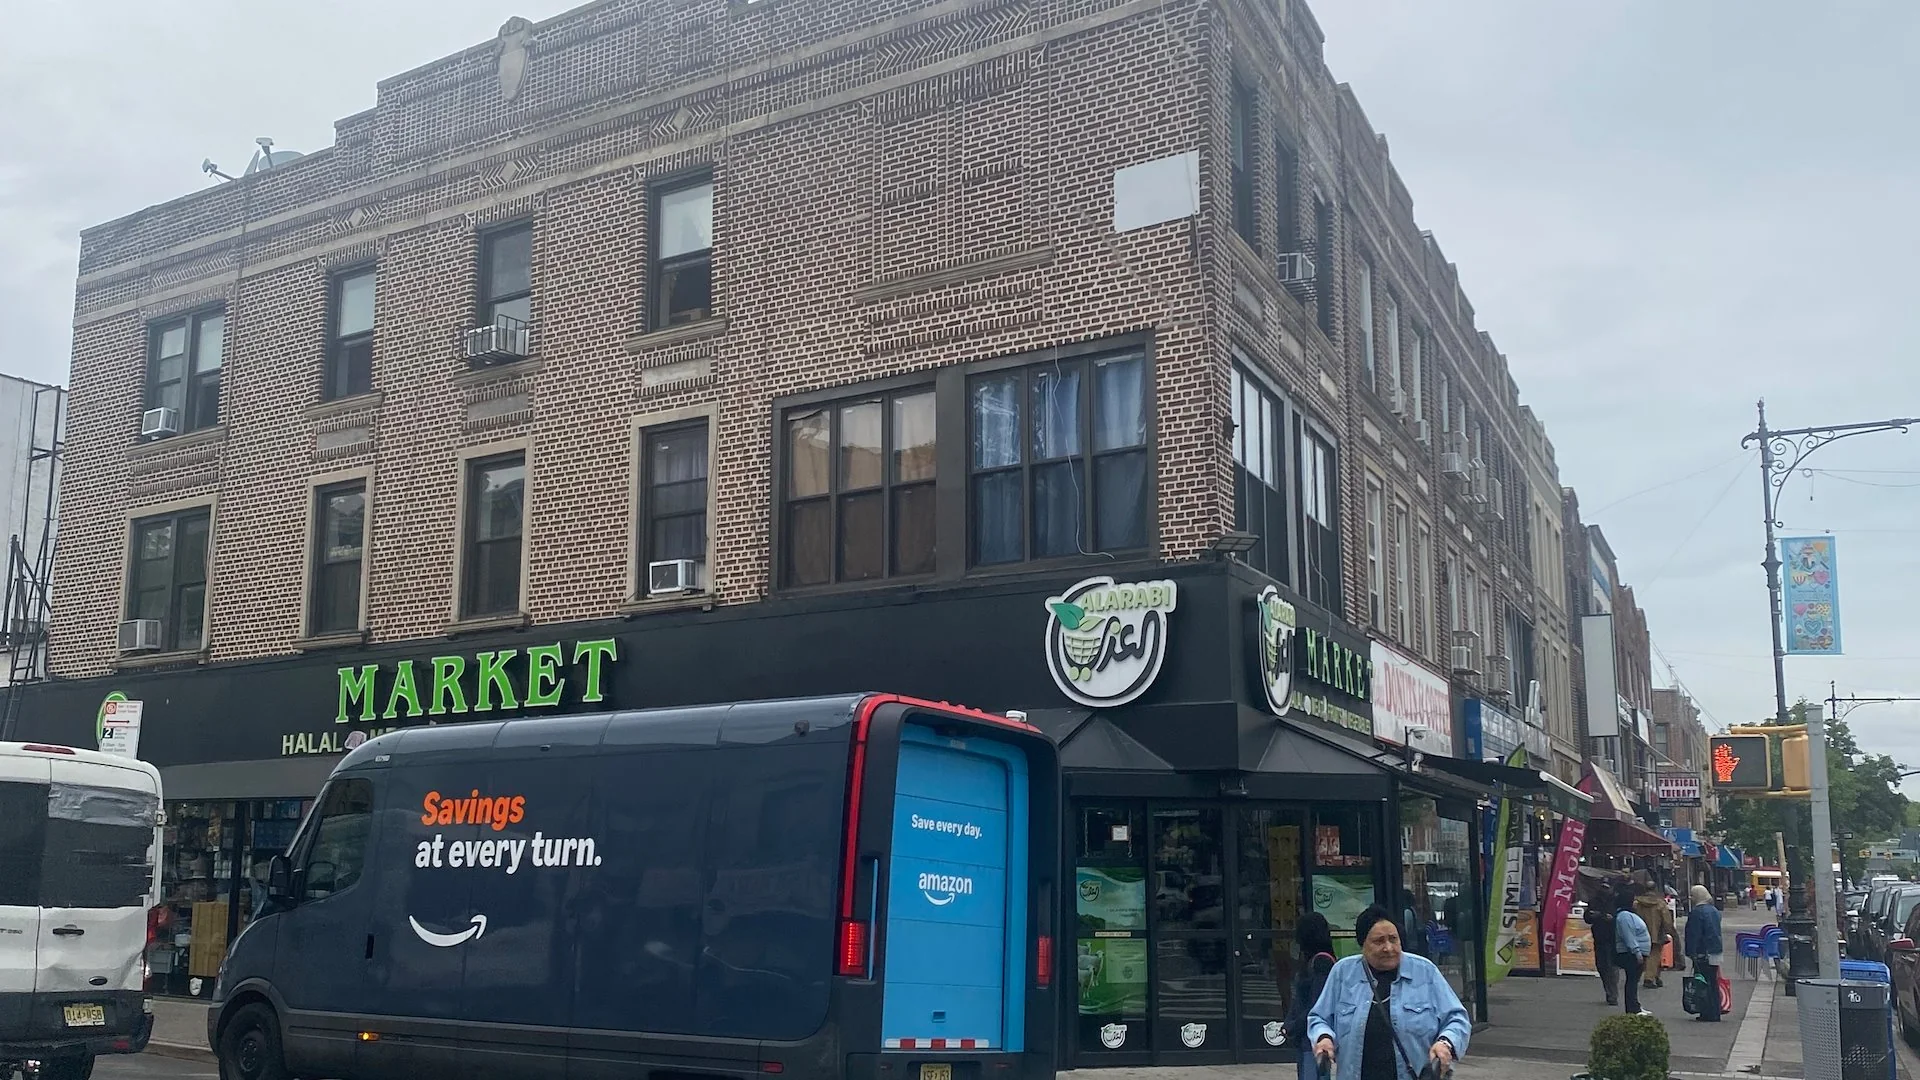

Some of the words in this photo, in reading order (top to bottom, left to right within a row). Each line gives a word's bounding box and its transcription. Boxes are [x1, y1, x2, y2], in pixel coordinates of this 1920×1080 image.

[1082, 587, 1170, 612] ALARABI
[335, 638, 617, 723] MARKET
[104, 728, 111, 738] 2
[281, 731, 343, 755] HALAL
[1659, 779, 1698, 787] PHYSICAL
[1661, 789, 1697, 798] THERAPY
[421, 789, 526, 831] Savings
[911, 813, 935, 831] Save
[936, 820, 963, 837] every
[964, 822, 982, 839] day.
[415, 834, 444, 867] at
[449, 839, 526, 874] every
[532, 831, 602, 867] turn.
[918, 872, 972, 895] amazon
[1502, 851, 1521, 929] SIMPLE
